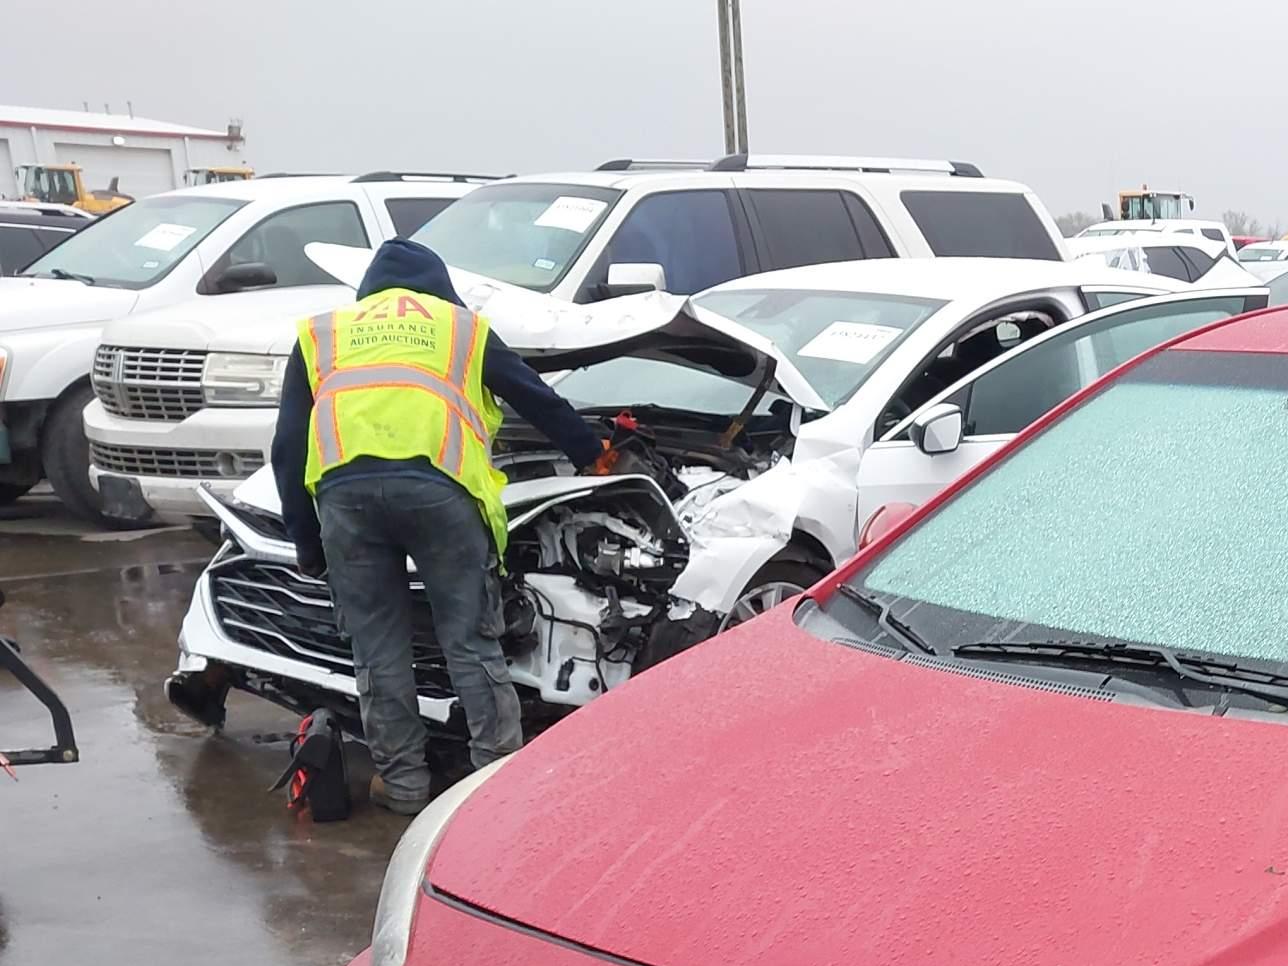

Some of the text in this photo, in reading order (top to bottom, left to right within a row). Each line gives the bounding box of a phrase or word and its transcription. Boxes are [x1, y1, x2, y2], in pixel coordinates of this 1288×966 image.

[350, 322, 437, 337] INSURANCE
[350, 334, 437, 351] AUTO AUCTIONS
